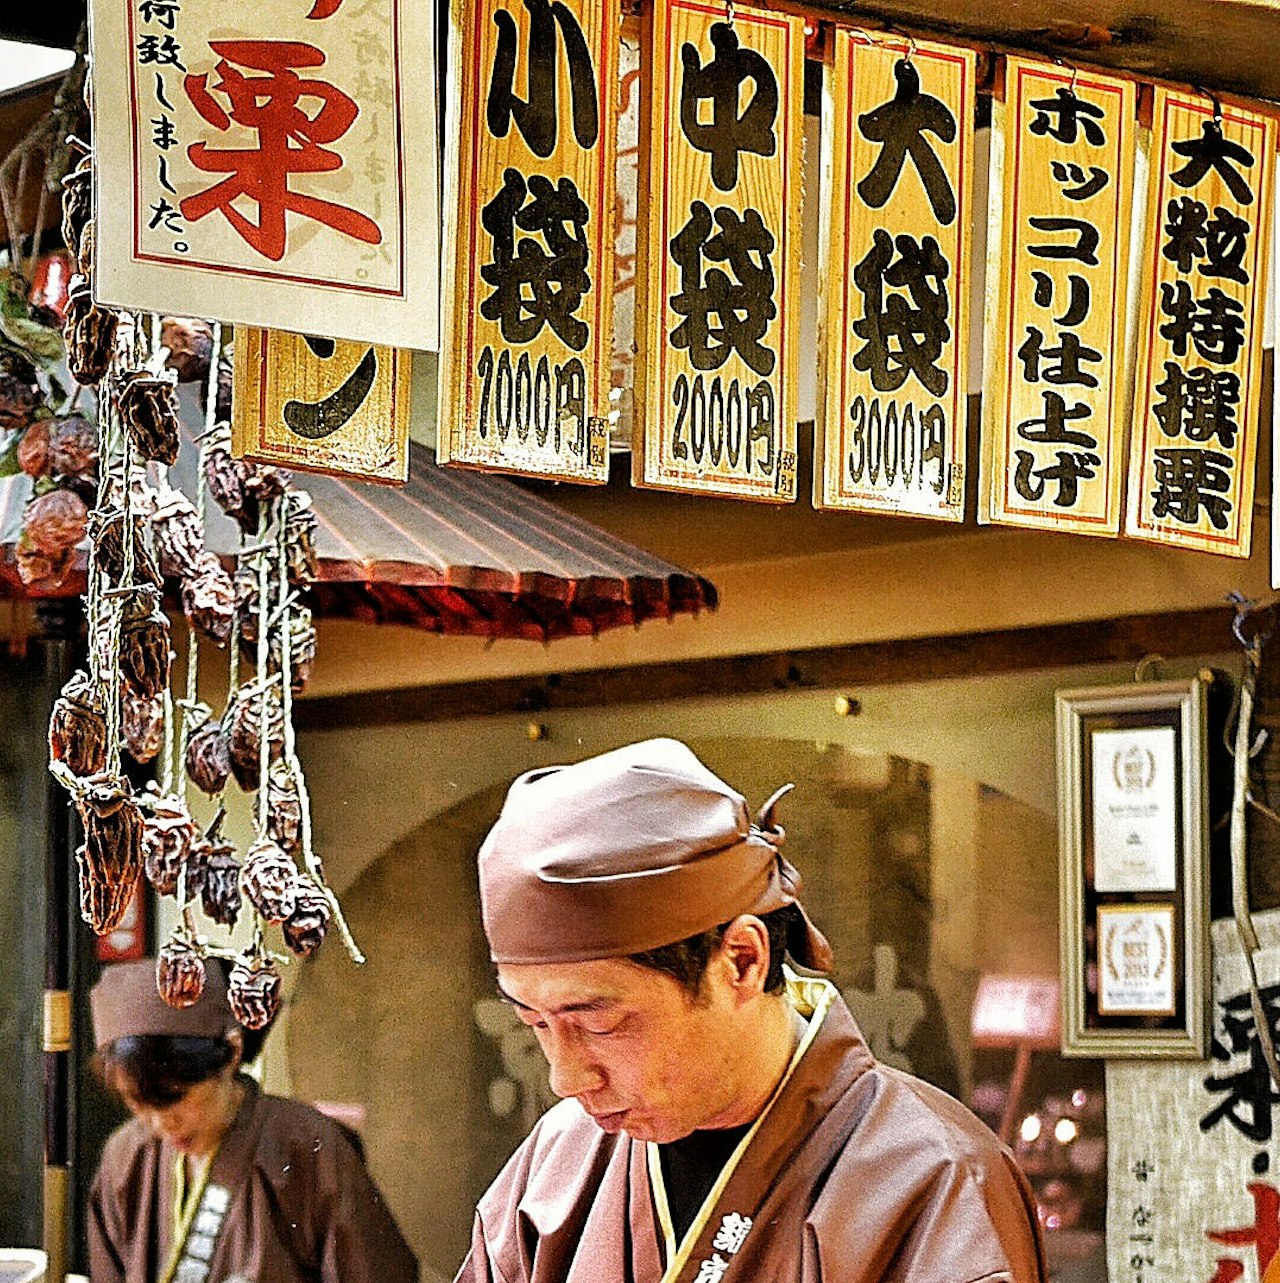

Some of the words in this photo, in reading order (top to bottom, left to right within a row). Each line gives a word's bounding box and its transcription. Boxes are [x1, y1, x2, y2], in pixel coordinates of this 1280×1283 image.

[177, 0, 382, 262] 栗
[480, 0, 598, 351] 小袋
[669, 21, 778, 377] 中袋
[853, 58, 957, 397] 大袋
[1014, 89, 1109, 507] ホッコリ仕上げ
[672, 374, 775, 476] 2000円
[848, 395, 946, 495] 3000円
[1151, 121, 1255, 531] 大粒特撰栗
